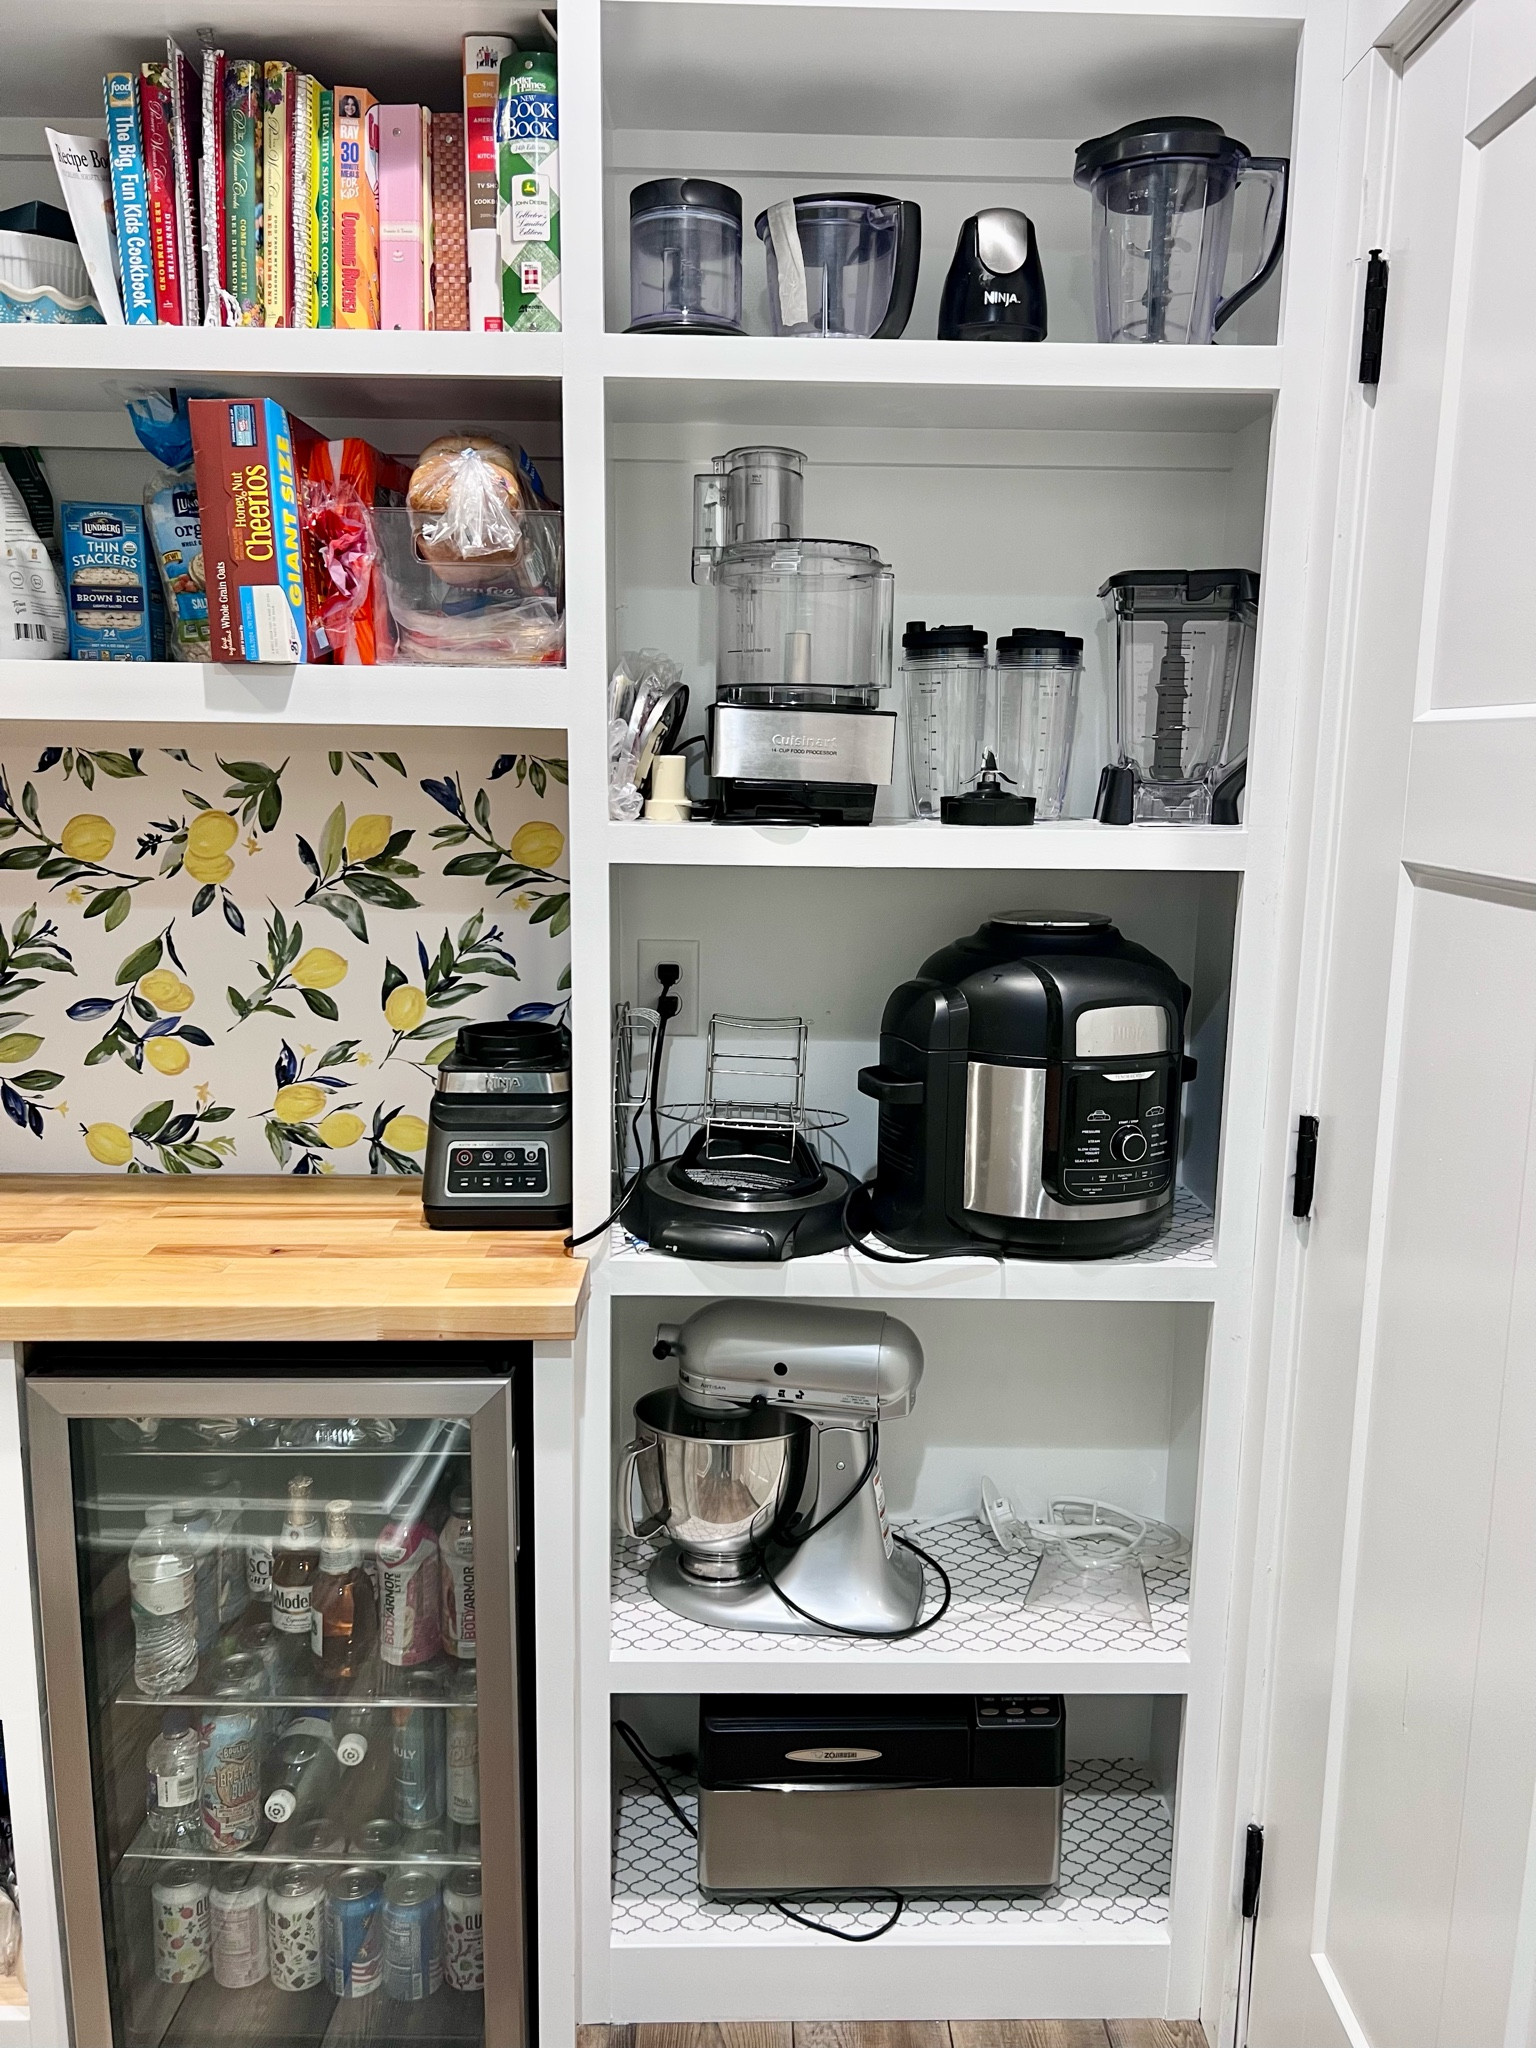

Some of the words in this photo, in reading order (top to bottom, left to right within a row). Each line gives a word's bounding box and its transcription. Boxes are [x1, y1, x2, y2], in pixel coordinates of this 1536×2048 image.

[111, 80, 131, 95] food
[510, 76, 533, 86] Better
[516, 81, 546, 93] Homes
[520, 94, 536, 102] NEW
[509, 99, 556, 120] COOK
[115, 115, 134, 142] The
[321, 112, 330, 163] HEALTHY
[340, 125, 360, 140] RAY
[508, 118, 555, 139] BOOK
[55, 143, 89, 172] Recipe
[114, 143, 137, 171] Big,
[231, 143, 248, 181] Woman
[340, 141, 360, 163] 30
[321, 166, 330, 197] SLOW
[340, 170, 360, 178] MEALS
[341, 177, 358, 188] FOR
[121, 173, 139, 201] Fun
[123, 203, 143, 234] Kids
[154, 201, 162, 223] REE
[321, 198, 330, 244] COOKER
[165, 213, 175, 280] DINNERTIME
[156, 228, 166, 291] DRUMMOND
[127, 236, 151, 309] Cookbook
[321, 246, 330, 308] COOKBOOK
[984, 290, 1018, 308] NINJA
[276, 434, 295, 505] SIZE
[231, 472, 243, 491] Nut
[235, 494, 248, 527] Honey
[245, 464, 274, 562] Cheerios
[84, 522, 121, 535] LUNDBERG
[175, 524, 202, 540] org
[87, 541, 119, 553] THIN
[164, 552, 179, 562] NEW!
[283, 508, 303, 607] GIANT
[72, 553, 138, 568] STACKERS
[216, 562, 227, 580] Oats
[76, 593, 113, 602] BROWN
[116, 595, 139, 603] RICE
[218, 581, 229, 603] Grain
[220, 604, 231, 630] Whole
[103, 629, 116, 637] 24
[772, 734, 837, 748] Cuisinart
[485, 1076, 521, 1093] NINJA
[384, 1572, 396, 1646] BODYARMOR
[463, 1566, 476, 1640] BODYARMOR
[465, 1913, 482, 1932] QU
